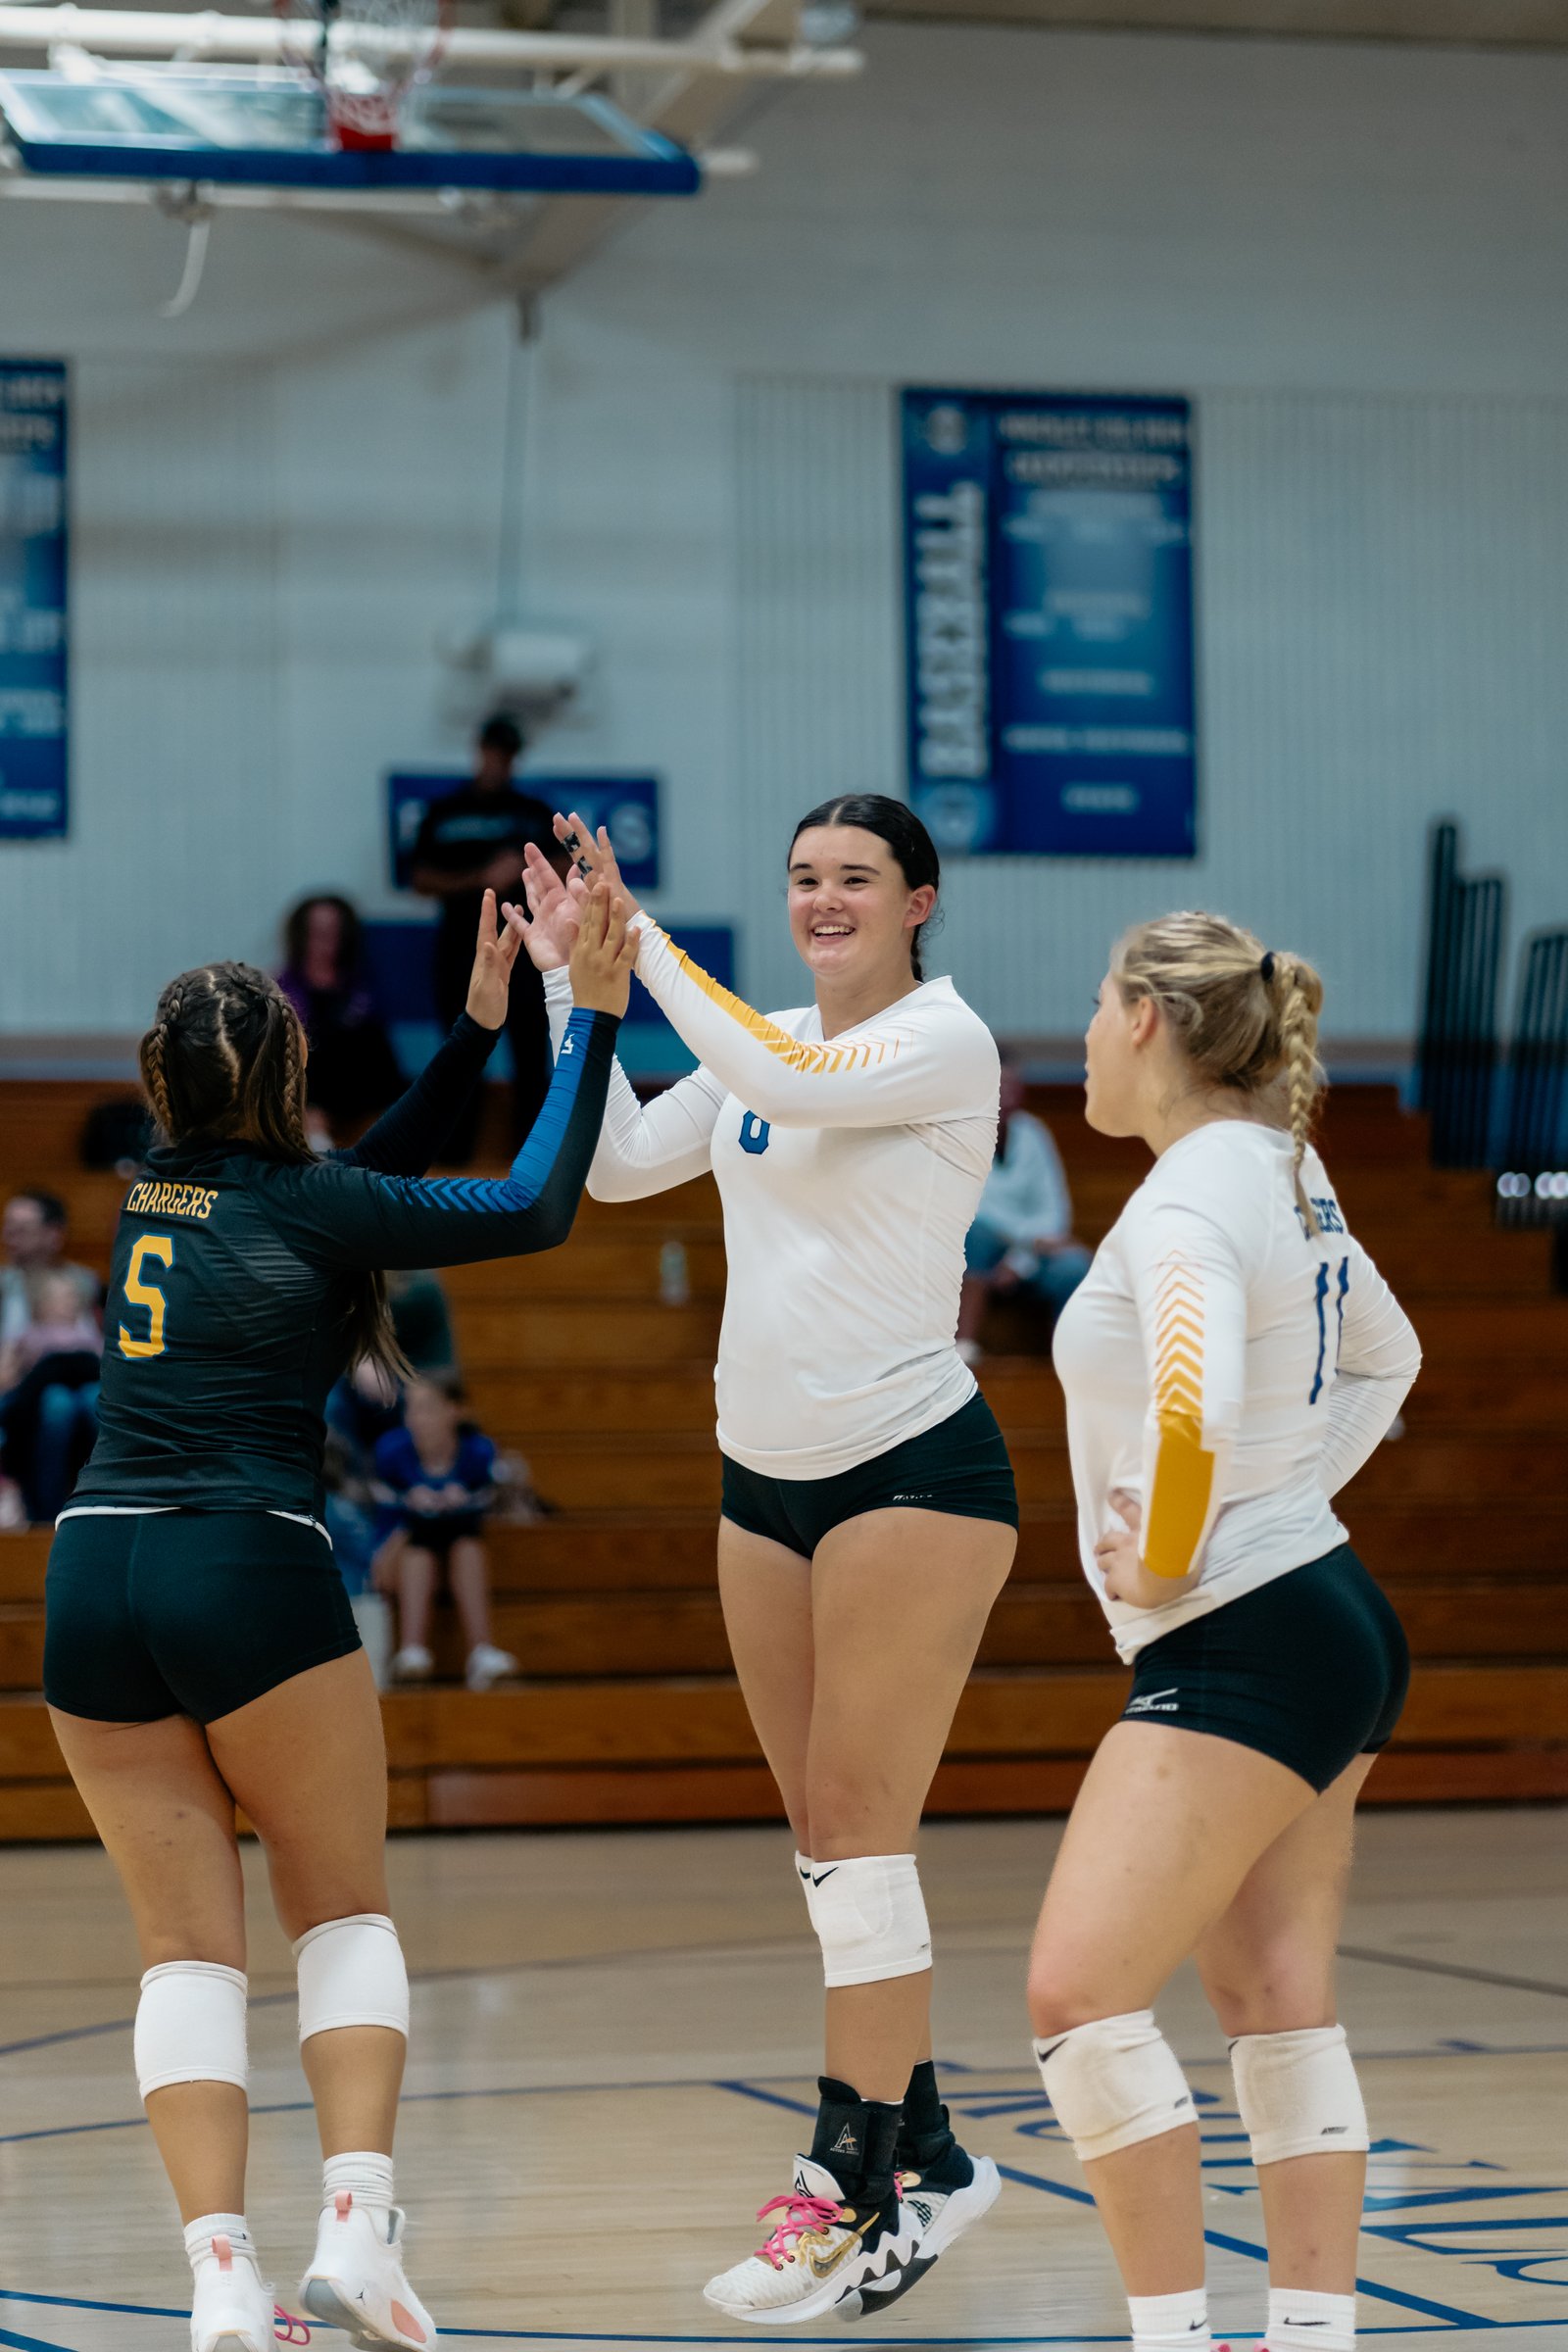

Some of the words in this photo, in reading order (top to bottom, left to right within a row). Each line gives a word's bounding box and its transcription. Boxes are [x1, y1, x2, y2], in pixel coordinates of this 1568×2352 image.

[126, 1182, 219, 1219] CHARGERS
[118, 1232, 174, 1361] 5
[1309, 1255, 1349, 1406] 11
